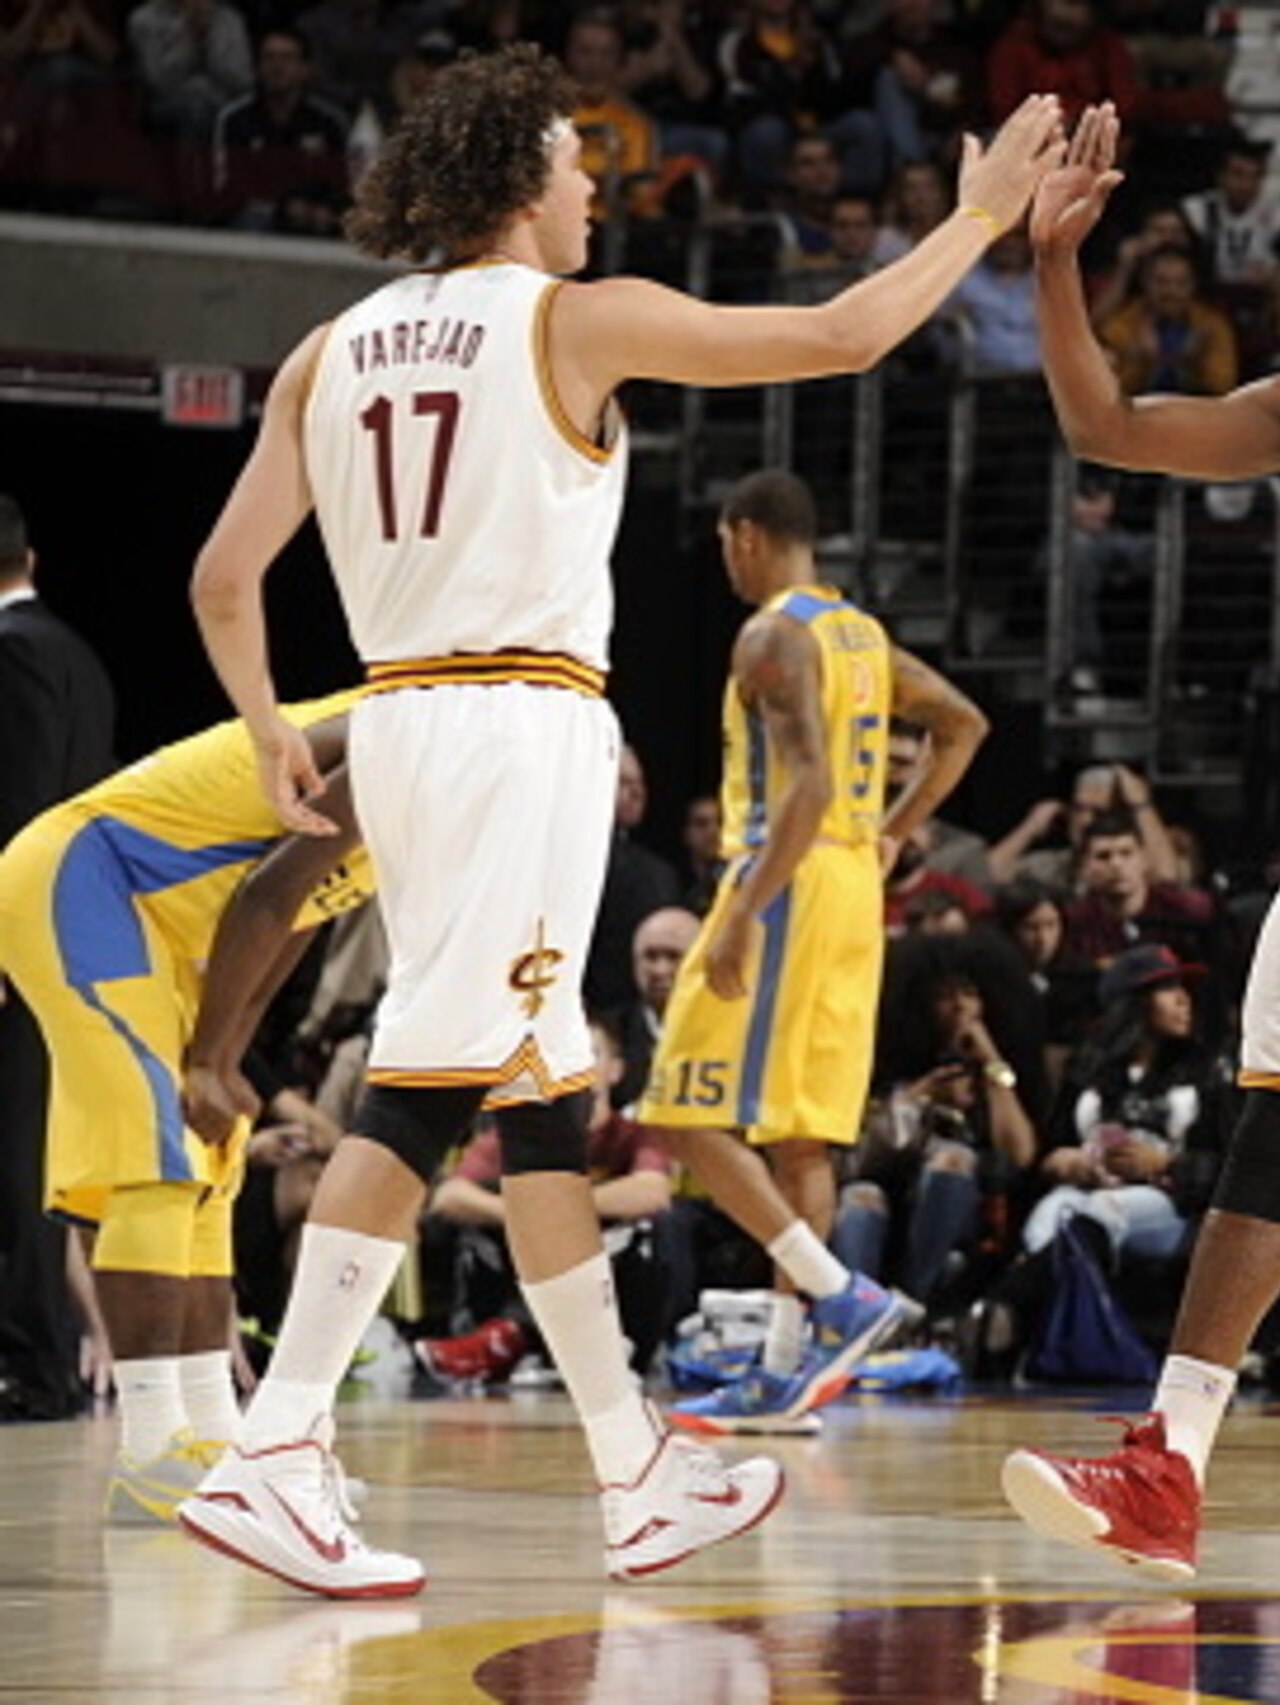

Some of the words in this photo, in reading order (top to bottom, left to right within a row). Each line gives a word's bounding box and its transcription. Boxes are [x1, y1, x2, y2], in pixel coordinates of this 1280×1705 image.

[349, 315, 486, 375] VAREJAO
[359, 390, 461, 542] 17
[673, 1058, 725, 1108] 15
